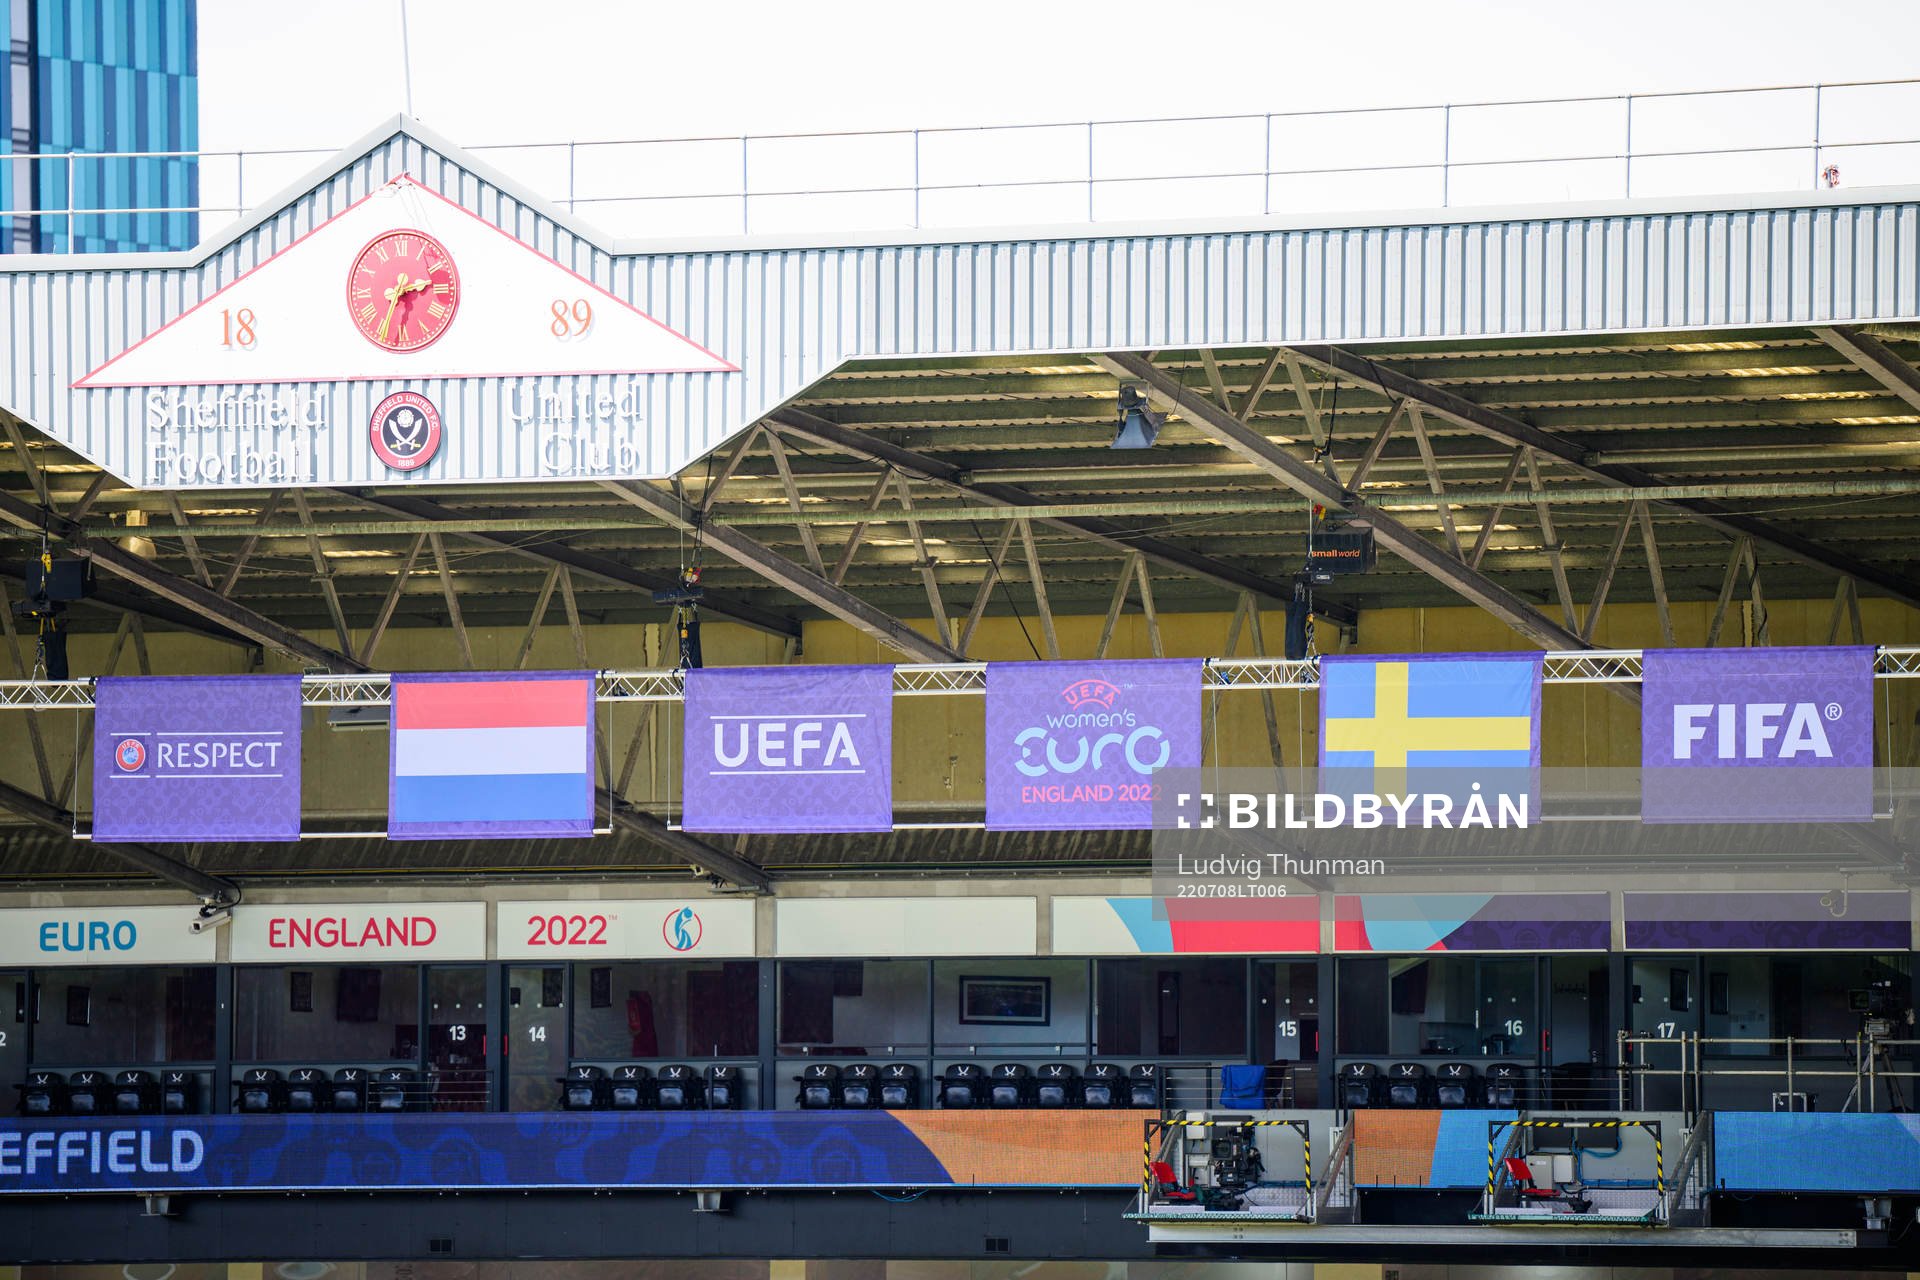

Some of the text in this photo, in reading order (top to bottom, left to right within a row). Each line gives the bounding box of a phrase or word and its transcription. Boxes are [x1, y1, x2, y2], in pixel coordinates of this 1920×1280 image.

[219, 308, 256, 346] 18
[550, 299, 592, 337] 89
[146, 380, 641, 428] Sheffield United
[372, 395, 403, 432] SHEFFIELD
[405, 395, 432, 414] UNITED
[146, 432, 637, 480] Football Club
[1065, 685, 1117, 705] UEFA
[1046, 708, 1137, 729] women's
[157, 742, 283, 768] RESPECT
[714, 721, 861, 767] UEFA
[1022, 783, 1162, 804] ENGLAND 2022
[39, 920, 137, 952] EURO
[268, 917, 437, 948] ENGLAND
[449, 1025, 467, 1041] 13
[528, 1026, 547, 1042] 14
[1278, 1020, 1297, 1037] 15
[1504, 1019, 1523, 1036] 16
[1657, 1022, 1676, 1039] 17
